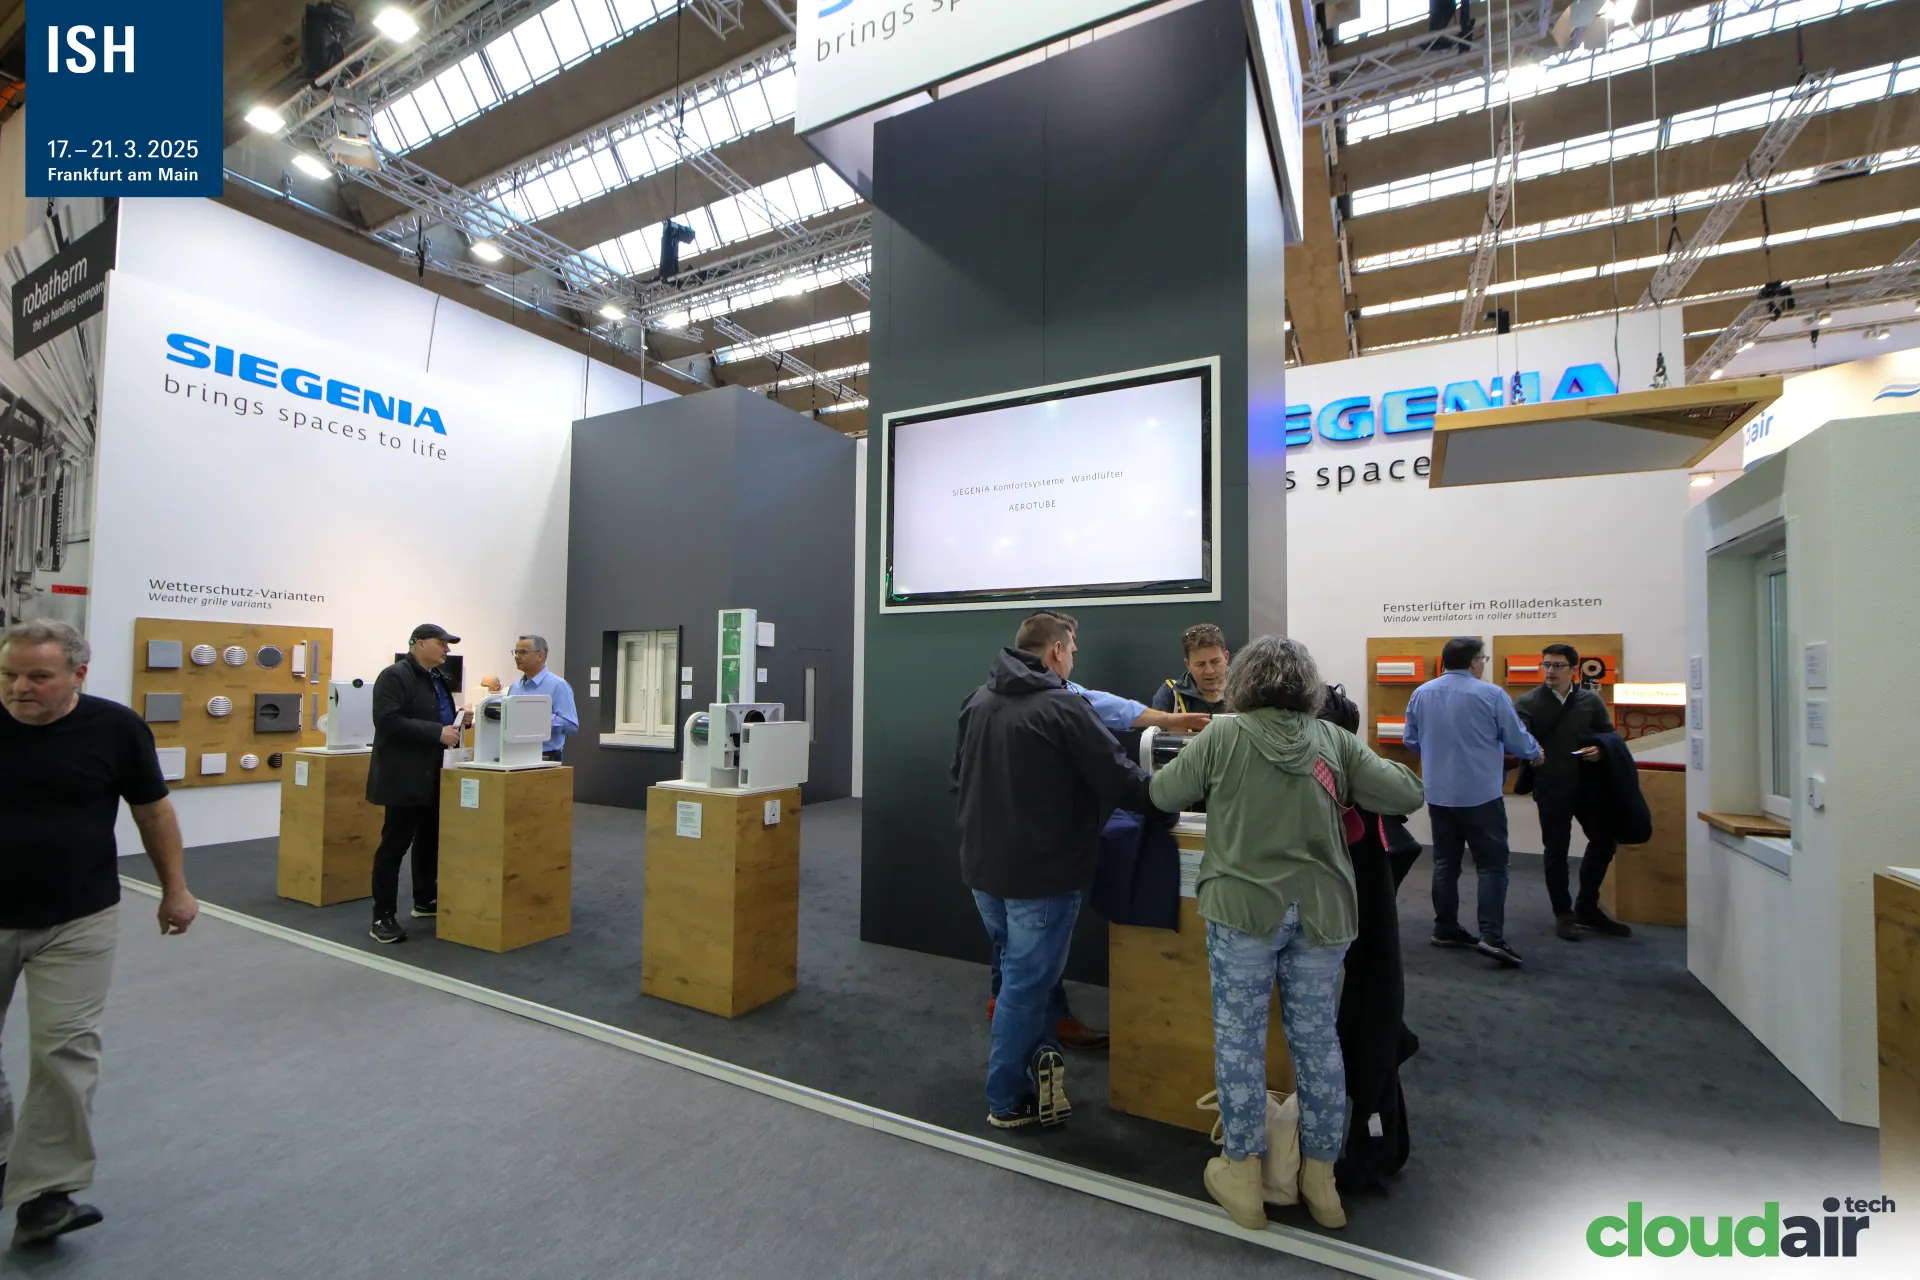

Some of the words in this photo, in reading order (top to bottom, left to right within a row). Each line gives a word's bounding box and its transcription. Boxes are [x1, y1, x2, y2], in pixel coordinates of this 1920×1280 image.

[817, 3, 915, 62] brings
[22, 257, 88, 318] robatherm
[32, 319, 42, 333] the
[42, 311, 51, 327] air
[51, 298, 77, 322] handling
[77, 280, 106, 306] company
[166, 333, 448, 435] SIEGENIA
[164, 373, 265, 416] brings
[278, 406, 368, 442] spaces
[379, 431, 402, 450] to
[412, 438, 448, 461] life
[1285, 363, 1619, 447] EGENIA
[952, 485, 990, 497] SIEGENIA
[1071, 470, 1125, 484] Wandlüfter
[1316, 455, 1431, 493] space
[1008, 499, 1057, 512] AEROTUBE
[148, 592, 198, 605] Weather
[200, 596, 229, 607] grille
[231, 599, 273, 610] variants
[149, 578, 325, 603] Wetterschutz-Varianten
[1383, 600, 1466, 613] Fensterlüfter
[1469, 600, 1486, 611] im
[1489, 597, 1603, 610] Rollladenkasten
[1383, 613, 1420, 623] Window
[1422, 612, 1473, 622] ventilators
[1475, 612, 1484, 621] in
[1487, 611, 1513, 621] roller
[1515, 610, 1558, 620] shutters
